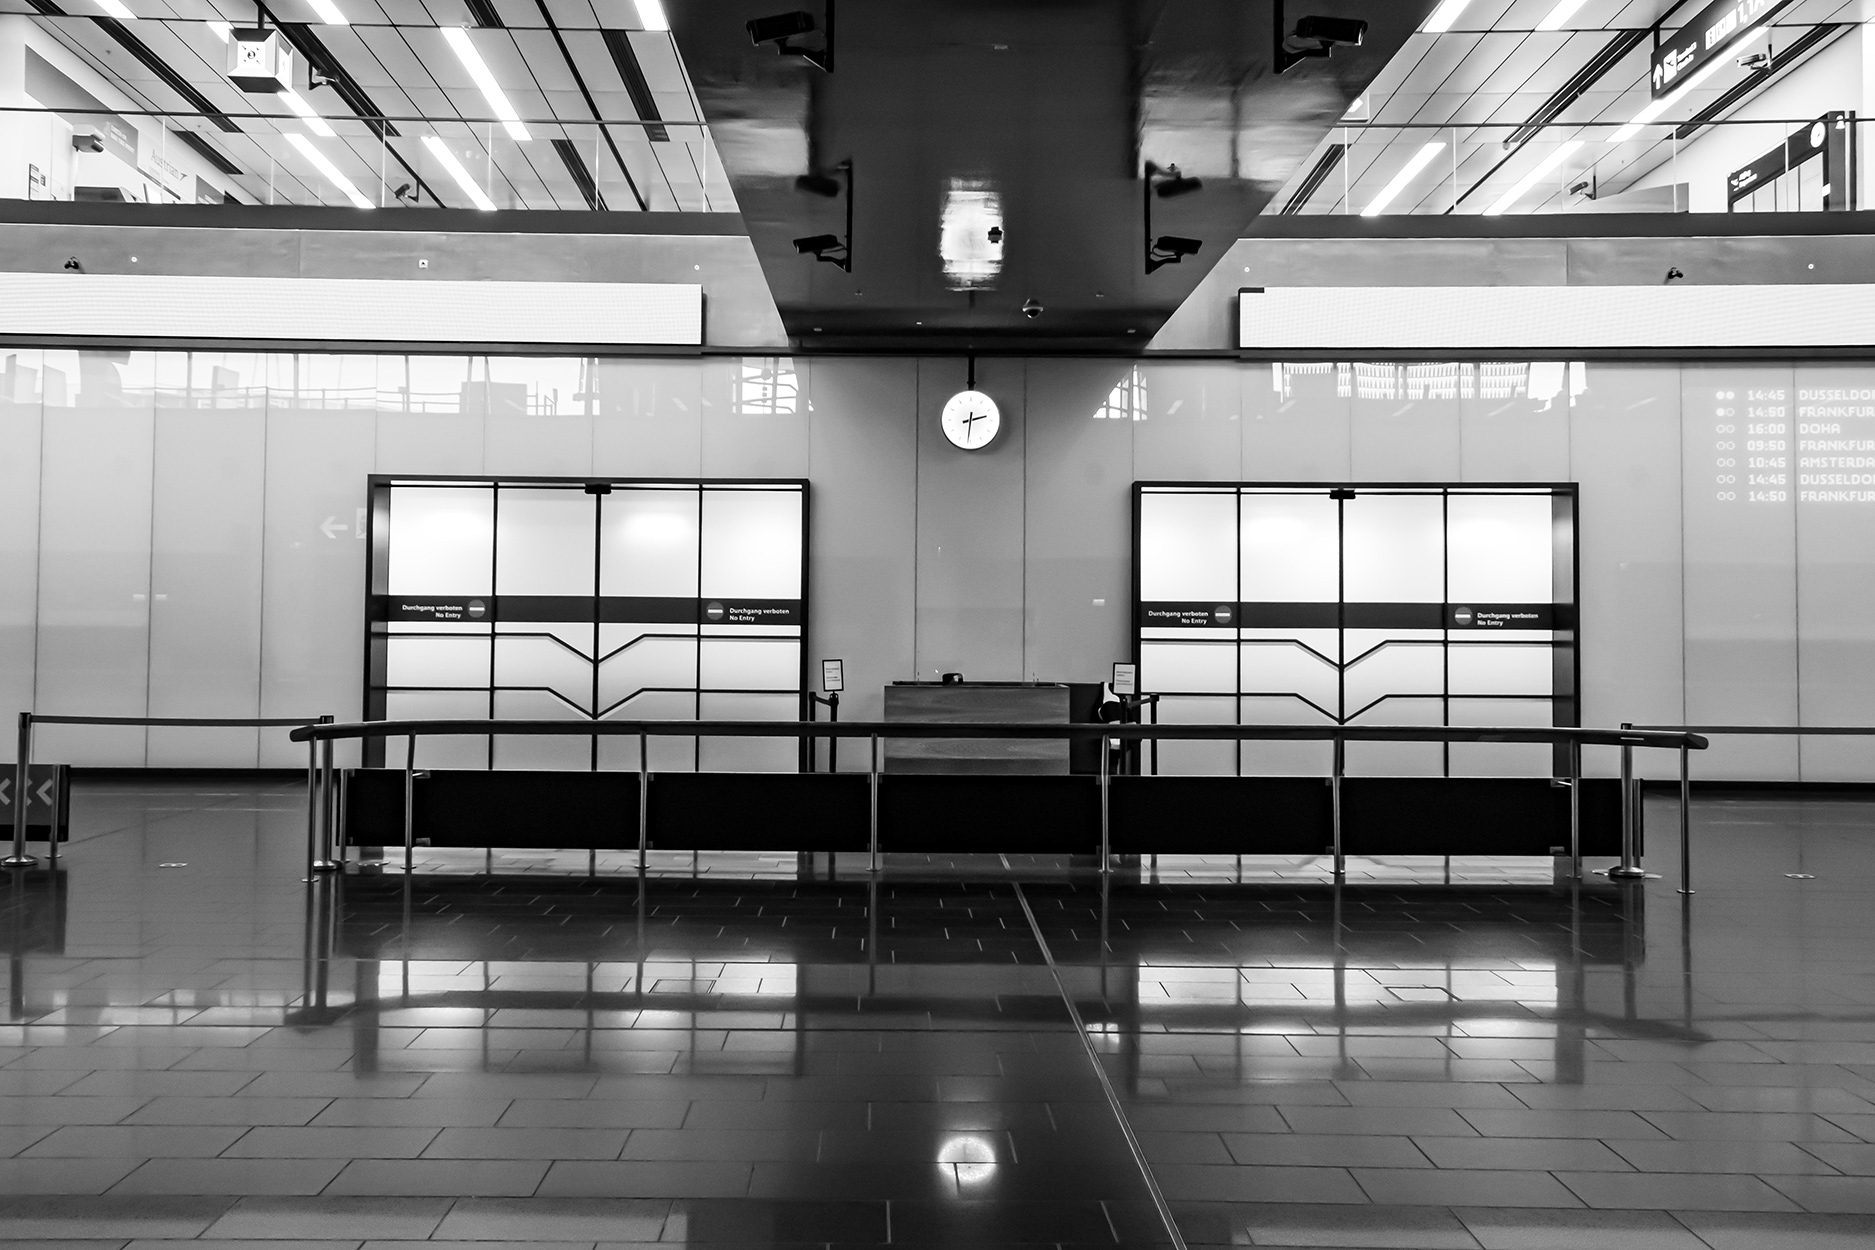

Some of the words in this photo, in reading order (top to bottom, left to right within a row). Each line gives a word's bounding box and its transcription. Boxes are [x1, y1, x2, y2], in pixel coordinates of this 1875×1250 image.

[1747, 390, 1785, 401] 14:45
[1748, 407, 1786, 417] 14:50
[1799, 406, 1875, 417] FRANKFUR
[1748, 423, 1786, 434] 16:00
[1799, 423, 1841, 434] DOHA
[1747, 440, 1786, 451] 09:50
[1800, 440, 1875, 451] FRANKFUR
[1748, 457, 1786, 468] 10:45
[1800, 457, 1875, 468] AMSTERDA
[1748, 474, 1786, 485] 14:45
[1800, 474, 1875, 485] DUSSELDO
[1749, 491, 1787, 502] 14:50
[1800, 490, 1875, 502] FRANKFUR
[402, 604, 435, 612] Durchgang
[729, 607, 762, 615] Durchgang
[1148, 610, 1181, 618] Durchgang
[1477, 612, 1510, 620] Durchgang
